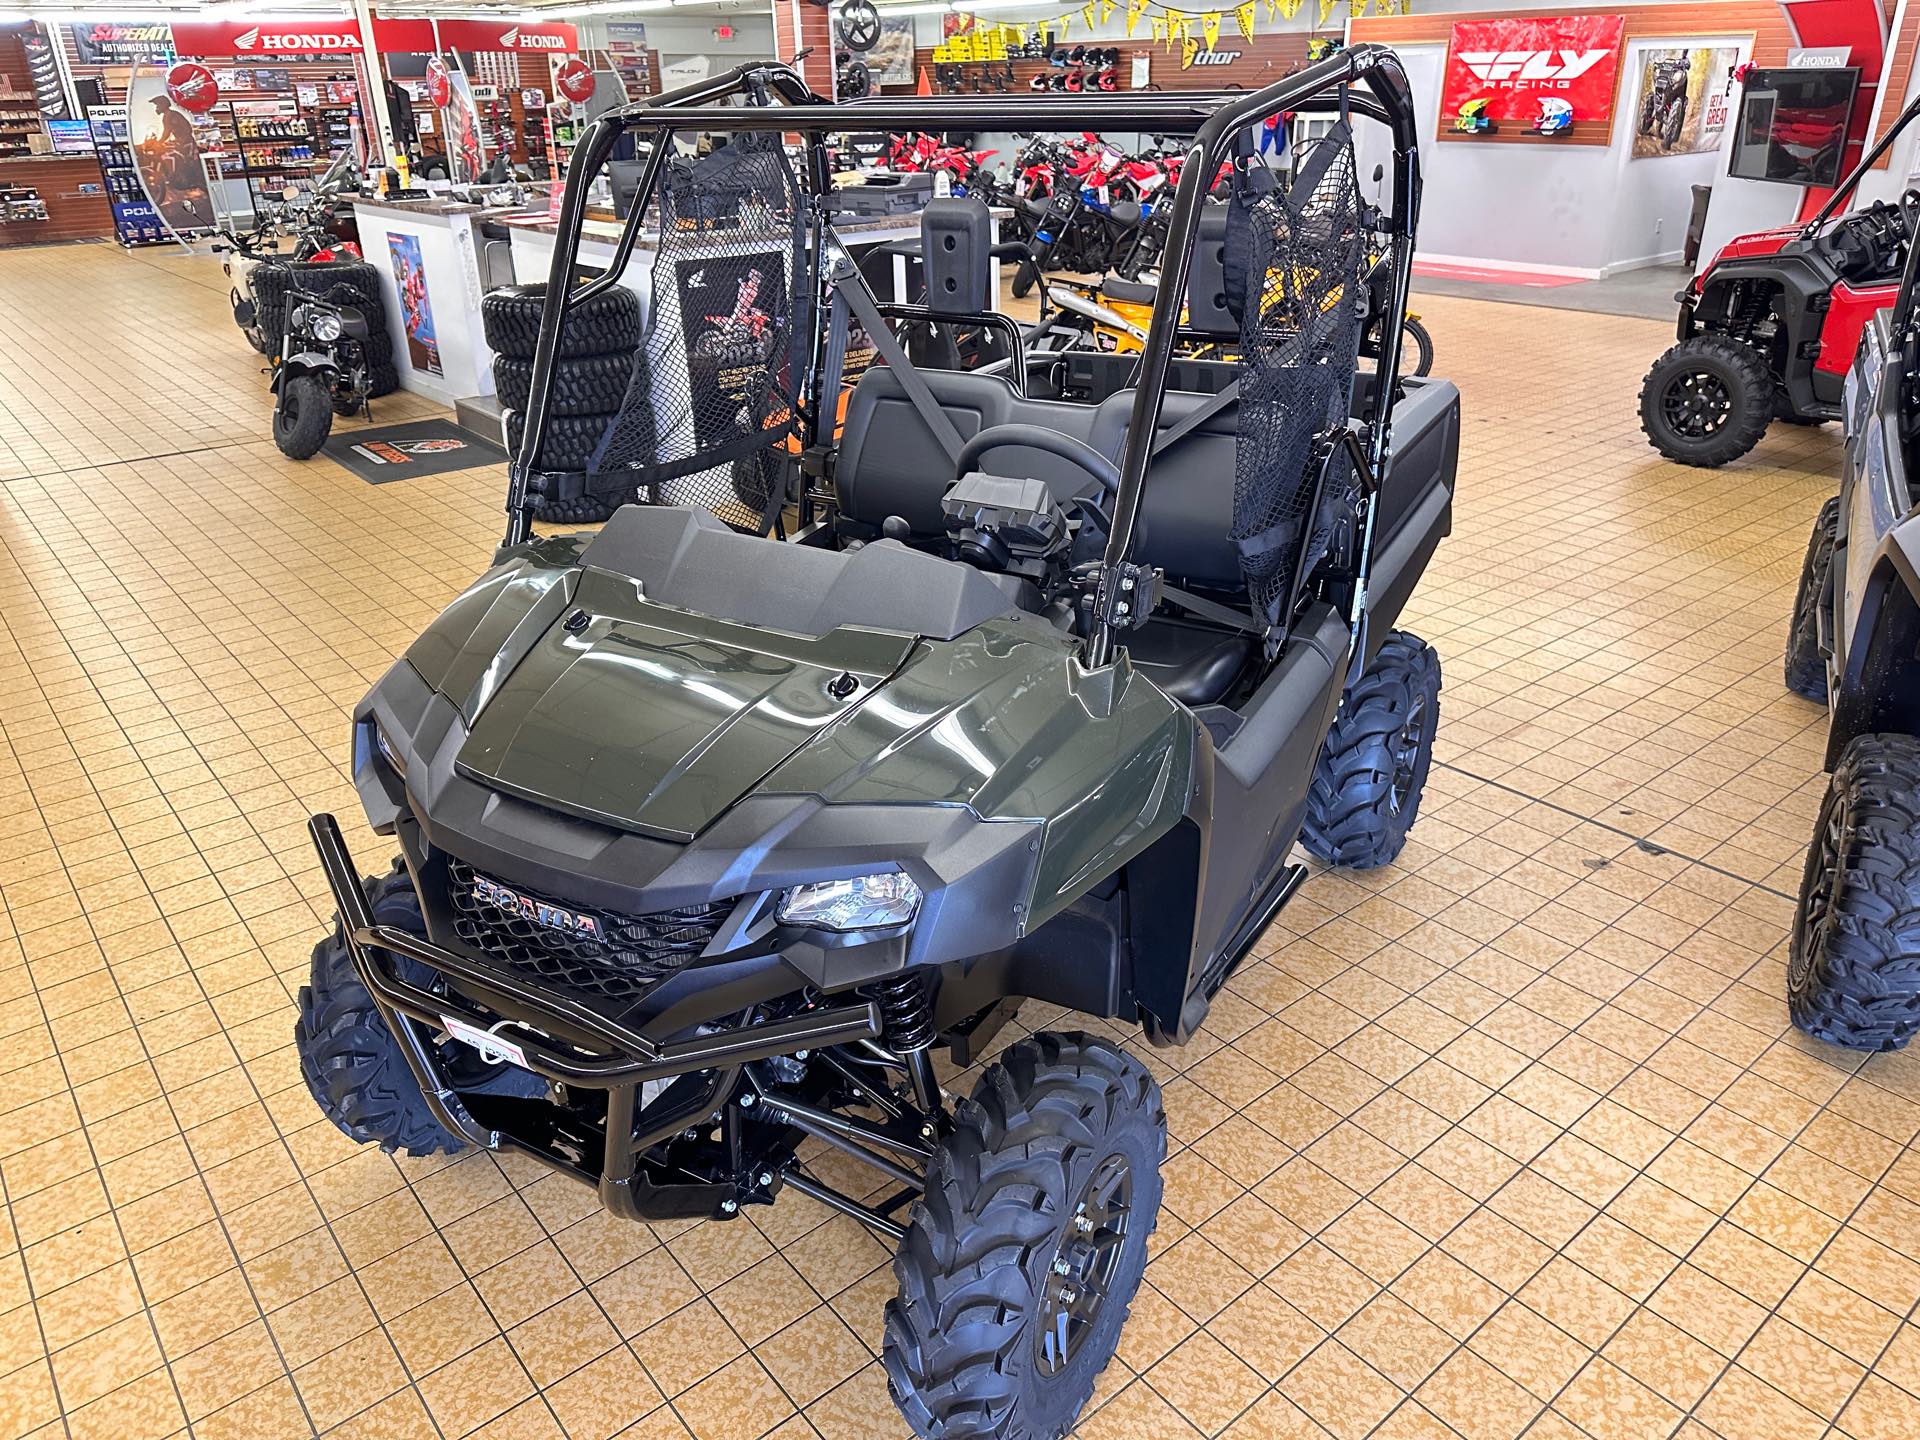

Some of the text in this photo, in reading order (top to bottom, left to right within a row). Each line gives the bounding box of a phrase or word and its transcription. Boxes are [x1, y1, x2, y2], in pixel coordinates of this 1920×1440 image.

[102, 43, 149, 53] AUTHORIZED
[261, 34, 363, 49] HONDA
[519, 34, 566, 49] HONDA
[1193, 49, 1242, 65] thor
[1457, 49, 1611, 80] FLY
[1801, 56, 1840, 66] HONDA
[1482, 80, 1570, 89] RACING
[1706, 108, 1728, 125] GREAT
[123, 207, 156, 216] POL
[471, 875, 607, 944] HONDA
